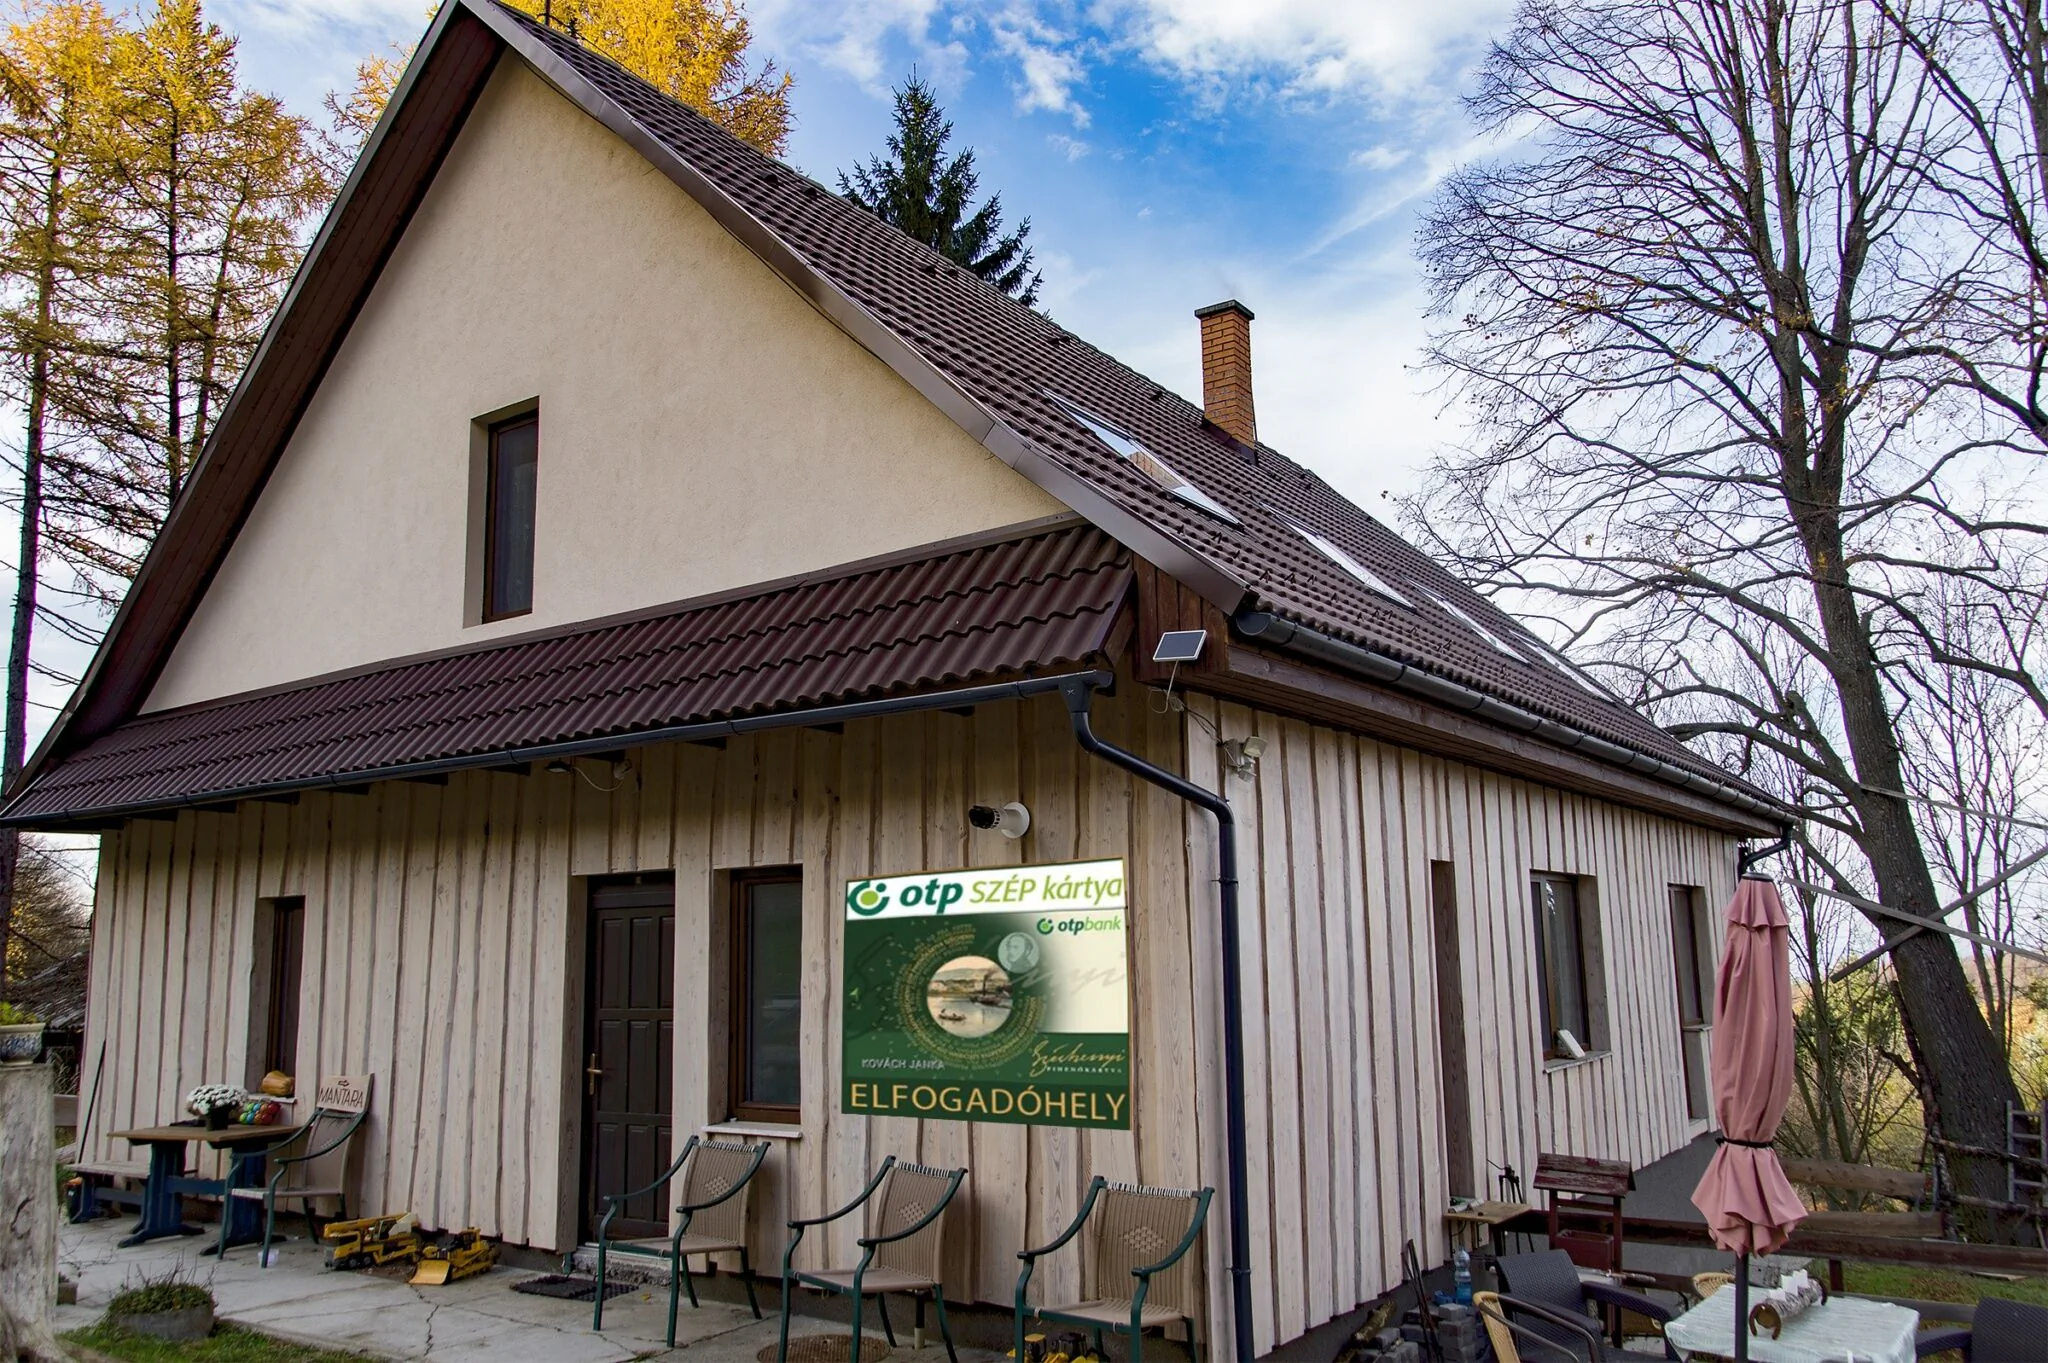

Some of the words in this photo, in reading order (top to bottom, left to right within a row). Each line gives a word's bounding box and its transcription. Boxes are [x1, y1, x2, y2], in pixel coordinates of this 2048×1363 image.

[899, 878, 963, 915] otp
[969, 874, 1036, 904] SZÉP
[1042, 875, 1123, 906] kártya
[850, 1083, 1127, 1121] ELFOGADÓHELY
